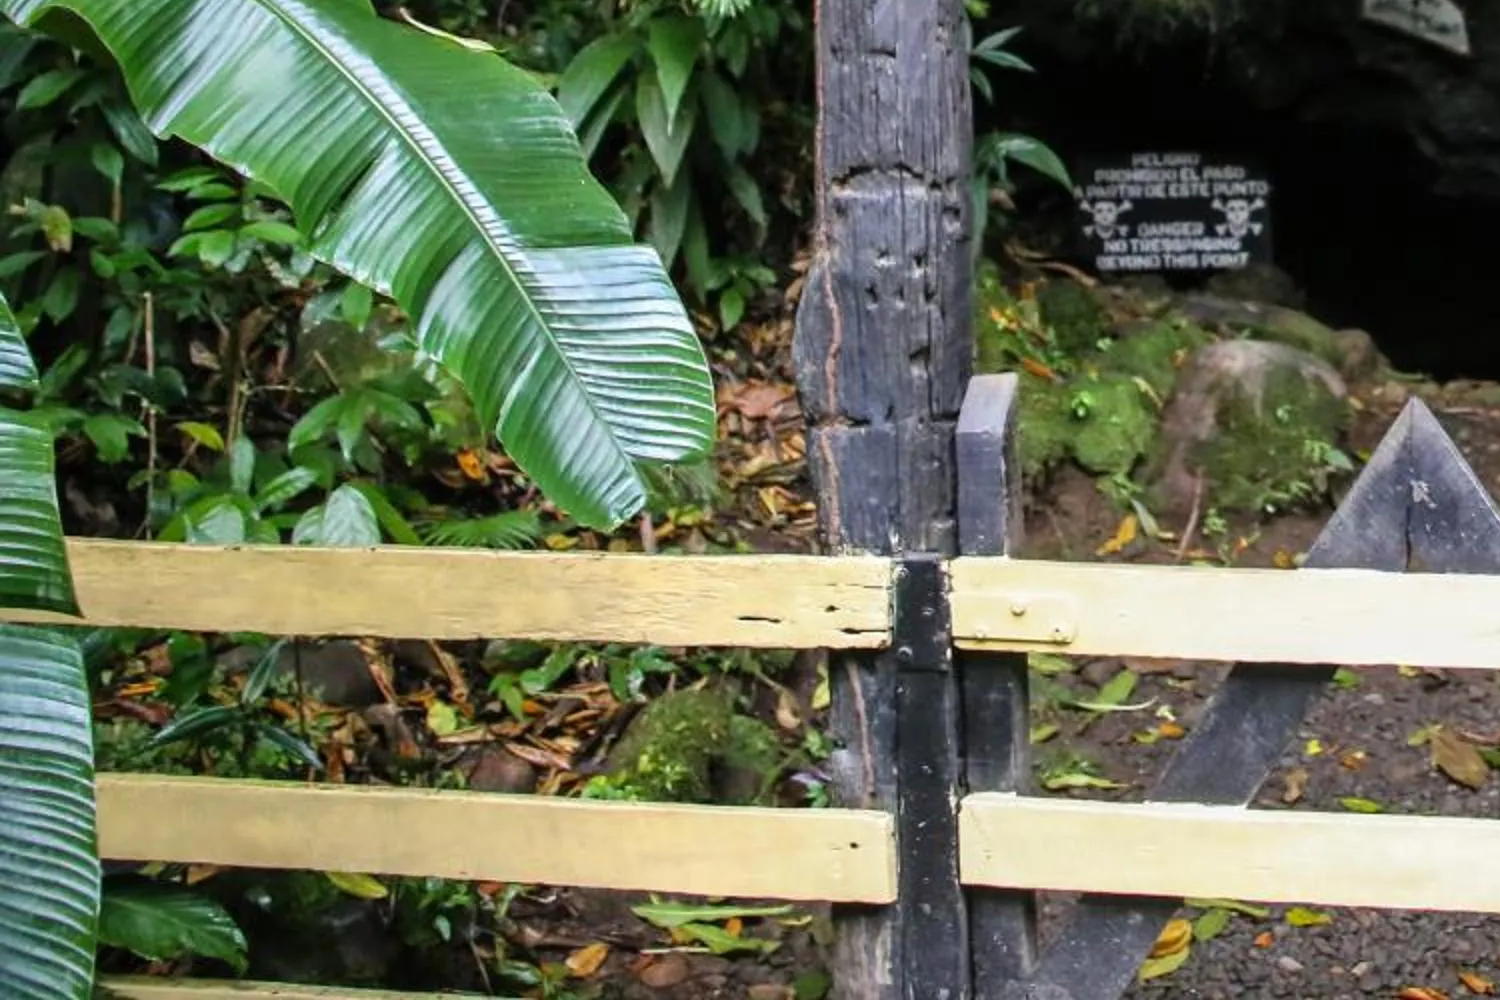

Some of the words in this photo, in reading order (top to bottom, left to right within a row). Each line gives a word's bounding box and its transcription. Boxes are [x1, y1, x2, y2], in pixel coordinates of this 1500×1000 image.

[1179, 167, 1200, 181] EL
[1074, 186, 1084, 198] A
[1145, 184, 1166, 197] DE
[1168, 182, 1210, 197] ESTE
[1213, 180, 1269, 195] PUNTO
[1137, 222, 1205, 236] DANGER
[1103, 239, 1129, 253] NO
[1096, 254, 1161, 270] BEYOND
[1163, 253, 1199, 269] THIS
[1201, 252, 1249, 268] POINT
